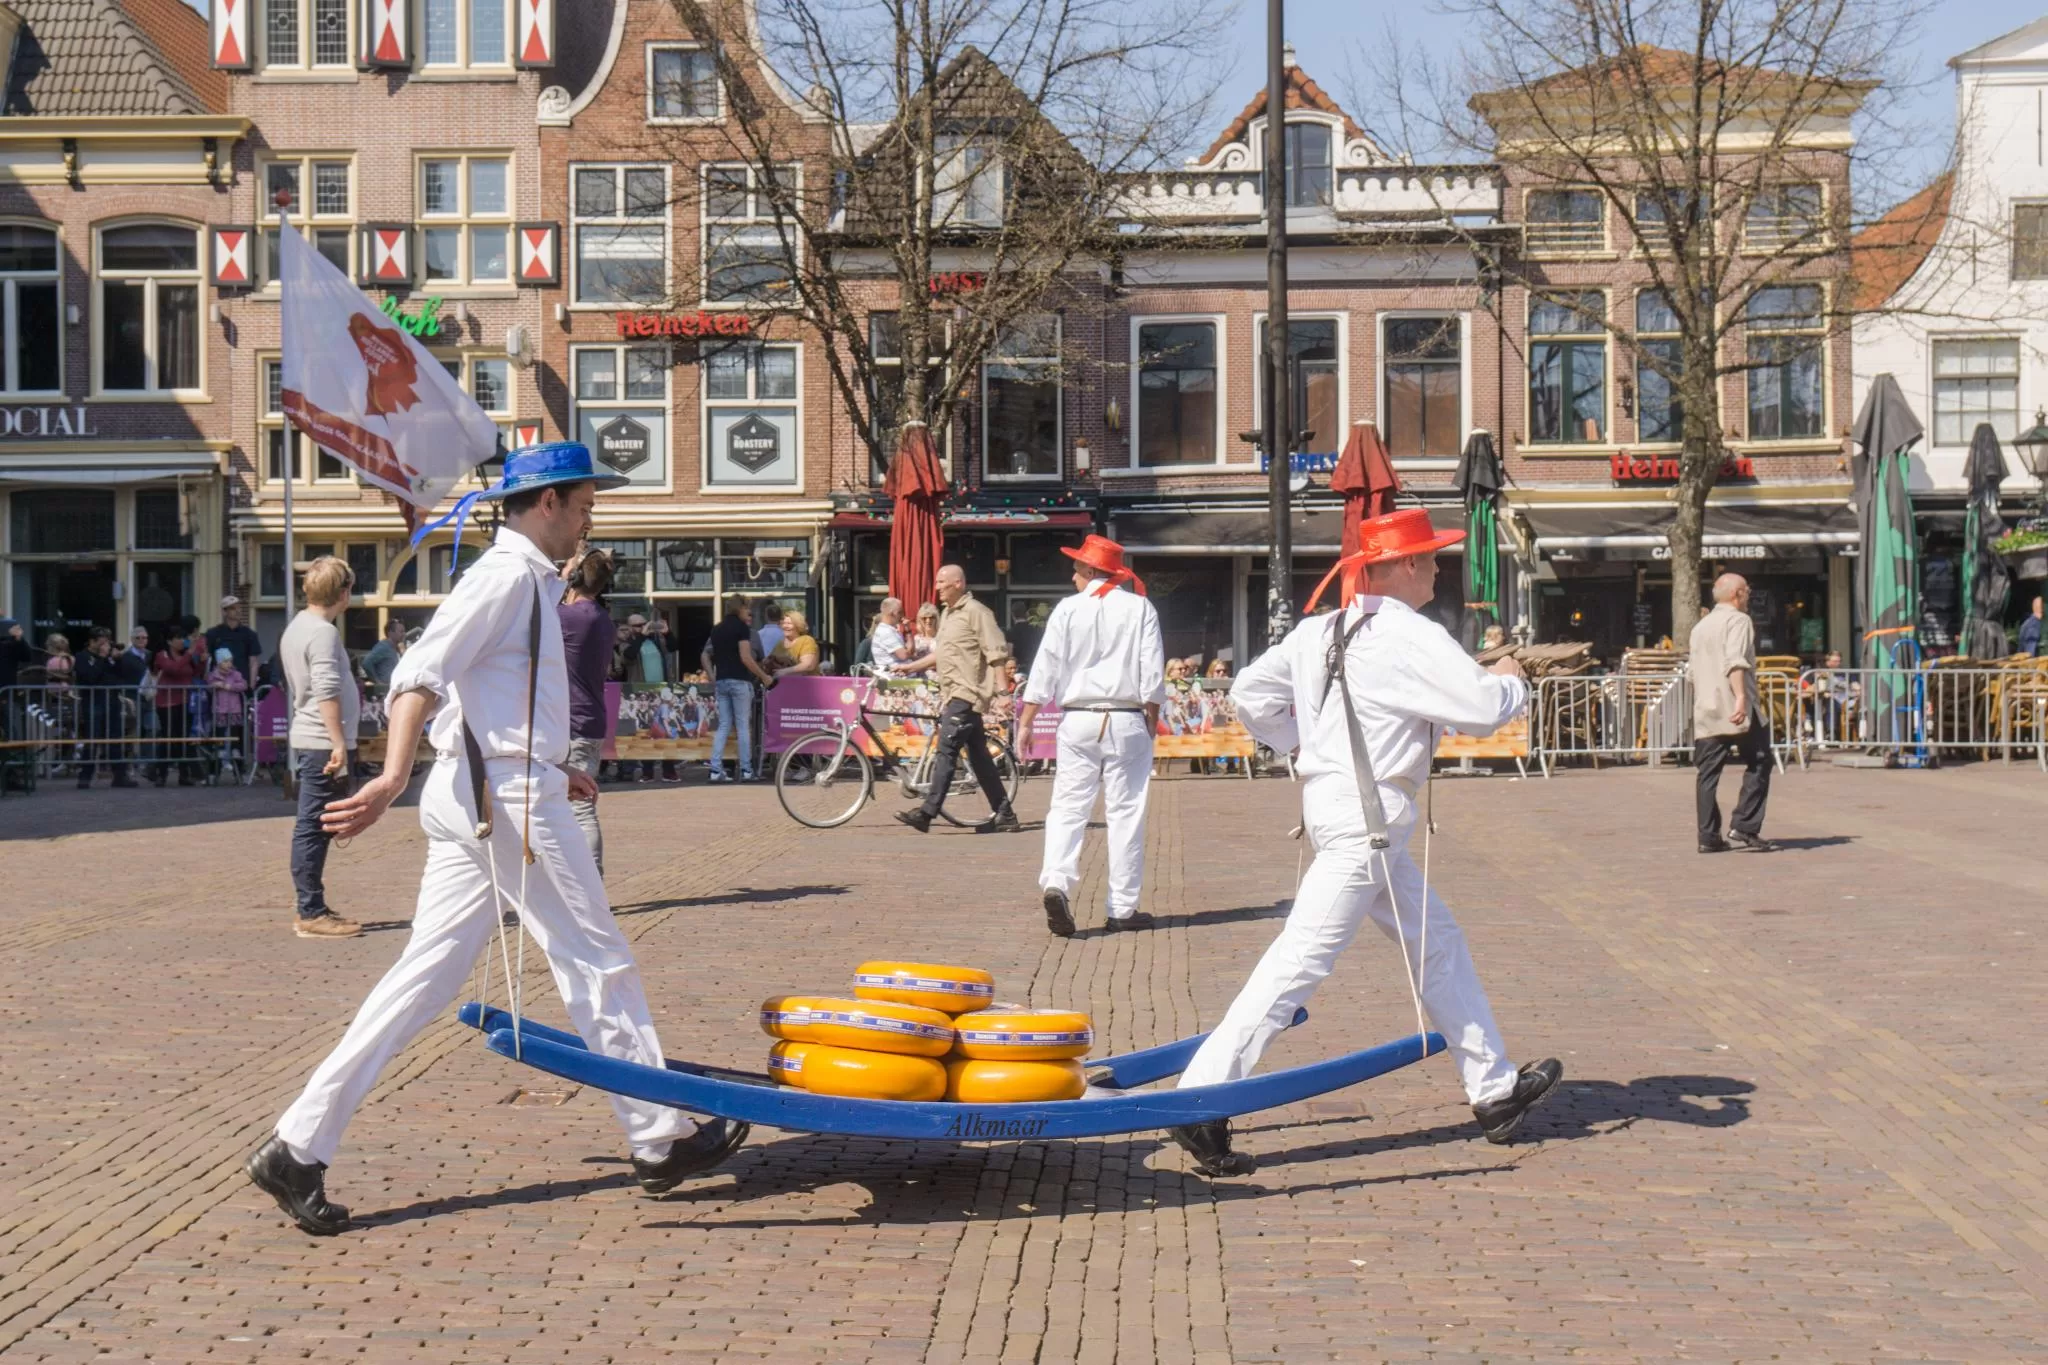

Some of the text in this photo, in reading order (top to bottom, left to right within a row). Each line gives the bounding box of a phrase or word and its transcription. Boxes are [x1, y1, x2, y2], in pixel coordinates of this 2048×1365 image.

[928, 271, 986, 293] AMST
[616, 310, 749, 336] Heineken
[733, 439, 774, 449] ROASTERY
[1610, 454, 1754, 479] Heinen
[944, 1111, 1049, 1137] Alkmaar
